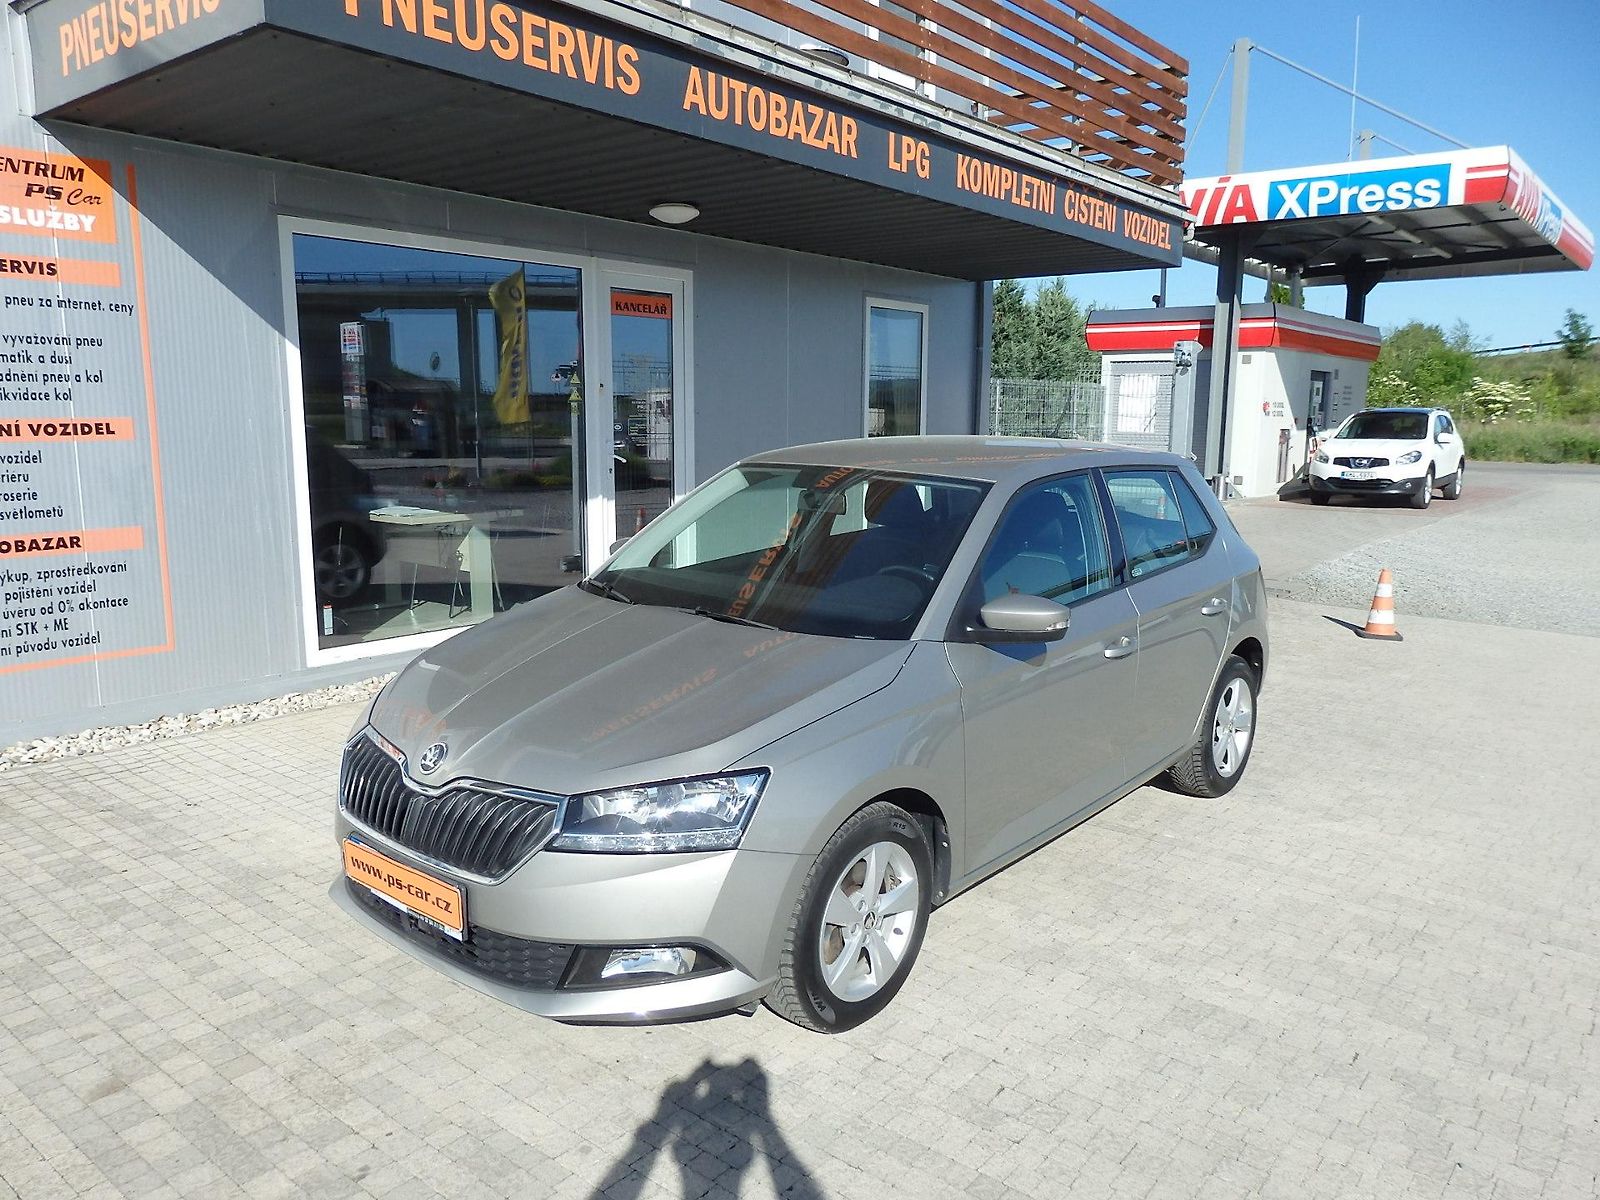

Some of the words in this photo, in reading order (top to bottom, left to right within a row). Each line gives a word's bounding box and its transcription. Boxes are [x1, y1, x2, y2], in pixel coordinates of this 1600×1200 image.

[59, 0, 221, 77] PNEUSER
[344, 0, 641, 96] NEUSERVIS
[682, 66, 858, 158] AUTOBAZAR
[888, 132, 930, 179] LPG
[1124, 209, 1172, 250] VOZIDEL
[25, 183, 63, 200] PS
[67, 188, 103, 205] Car
[1275, 178, 1441, 220] XPress
[0, 204, 96, 232] SLUŽBY
[0, 258, 58, 276] ERVIS
[5, 296, 34, 308] pneu
[38, 298, 52, 307] za
[57, 295, 105, 311] internet.
[109, 304, 134, 317] ceny
[615, 301, 667, 315] KANCELÁŘ
[75, 337, 103, 349] pneu
[38, 355, 45, 363] a
[42, 373, 70, 385] pneu
[75, 374, 81, 382] a
[86, 370, 103, 382] kol
[54, 387, 72, 400] kol
[28, 422, 116, 437] VOZIDEL
[0, 450, 42, 464] vozidel
[0, 535, 82, 553] OBAZAR
[57, 579, 97, 595] vozidel
[40, 602, 54, 615] od
[58, 599, 75, 613] 0%
[79, 597, 129, 611] akontace
[16, 621, 39, 636] STK
[54, 617, 69, 632] ME
[62, 631, 101, 648] vozidel
[351, 856, 453, 914] www.ps-car.cz
